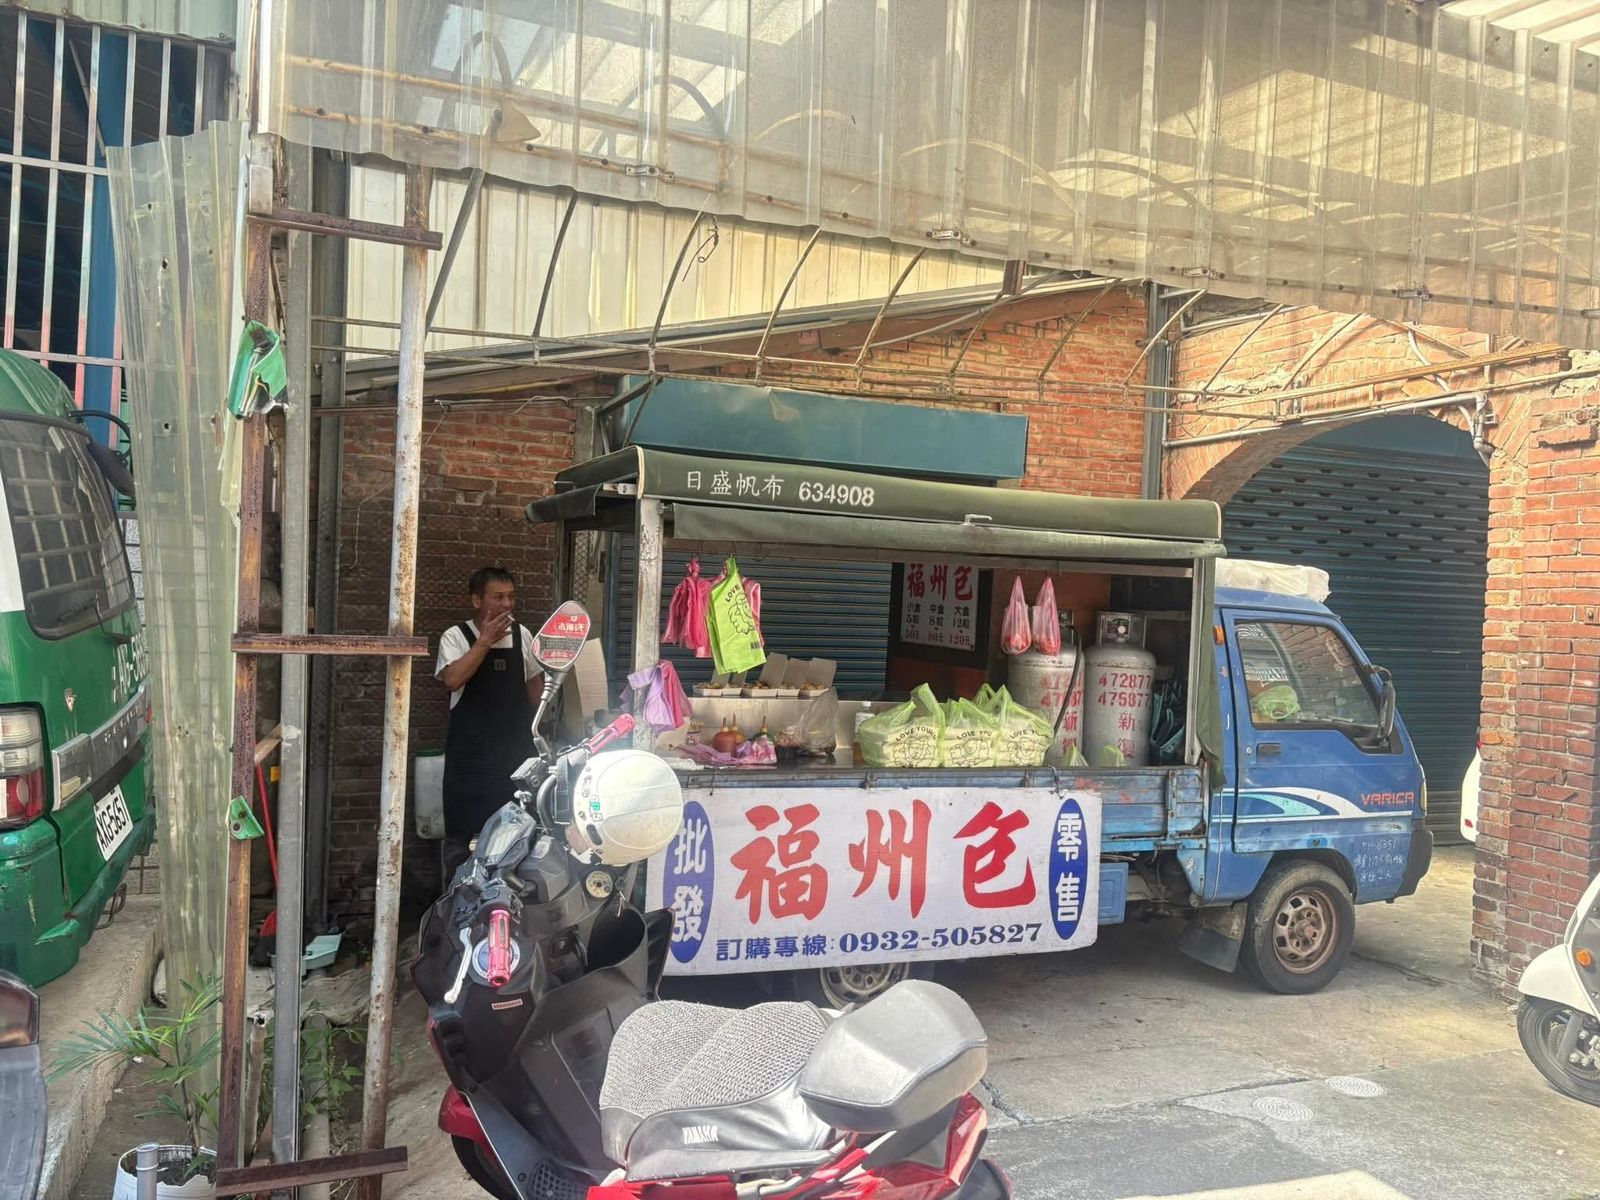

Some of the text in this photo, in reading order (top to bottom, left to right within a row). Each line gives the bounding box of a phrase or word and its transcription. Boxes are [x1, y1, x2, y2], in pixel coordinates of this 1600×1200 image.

[687, 470, 875, 507] 日盛帆布 634908
[1361, 792, 1415, 806] VARICA
[671, 817, 708, 943] 批發
[1056, 812, 1082, 922] 零售
[682, 1124, 719, 1145] YAMAHA
